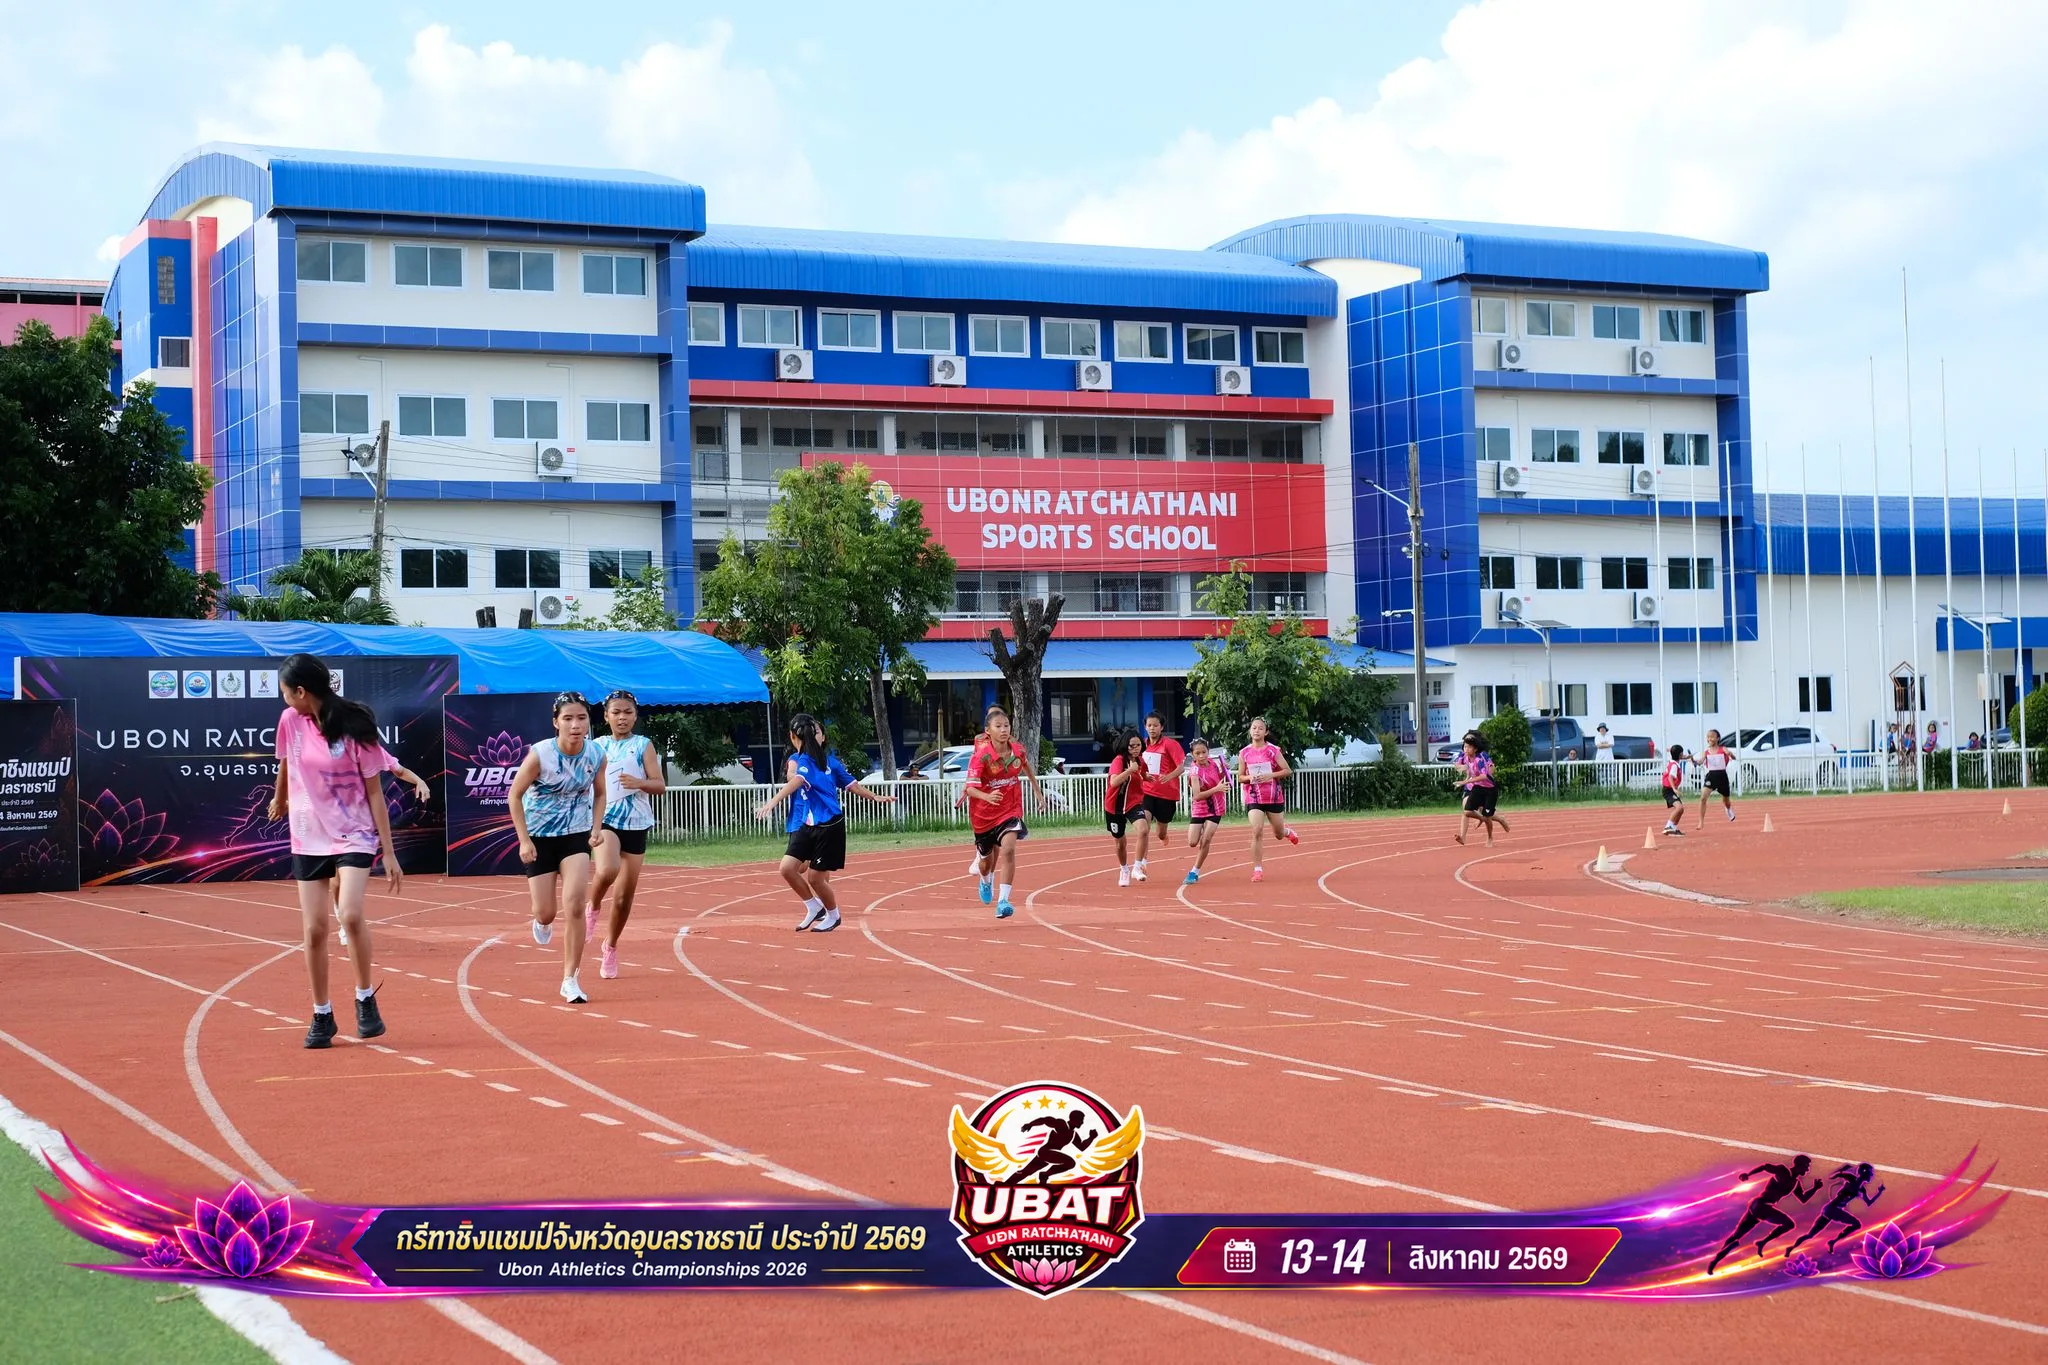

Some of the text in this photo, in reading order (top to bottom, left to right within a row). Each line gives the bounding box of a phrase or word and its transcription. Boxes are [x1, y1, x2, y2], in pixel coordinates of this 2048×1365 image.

[946, 487, 1237, 517] UBONRATCHATHANI
[982, 523, 1216, 550] SPORTS SCHOOL
[96, 728, 190, 749] UBON
[0, 757, 71, 778] าชิงแชมป์
[180, 763, 281, 782] จ.อุบลราช
[464, 767, 520, 786] UBO
[466, 786, 510, 797] ATHLE
[38, 810, 58, 819] 2569
